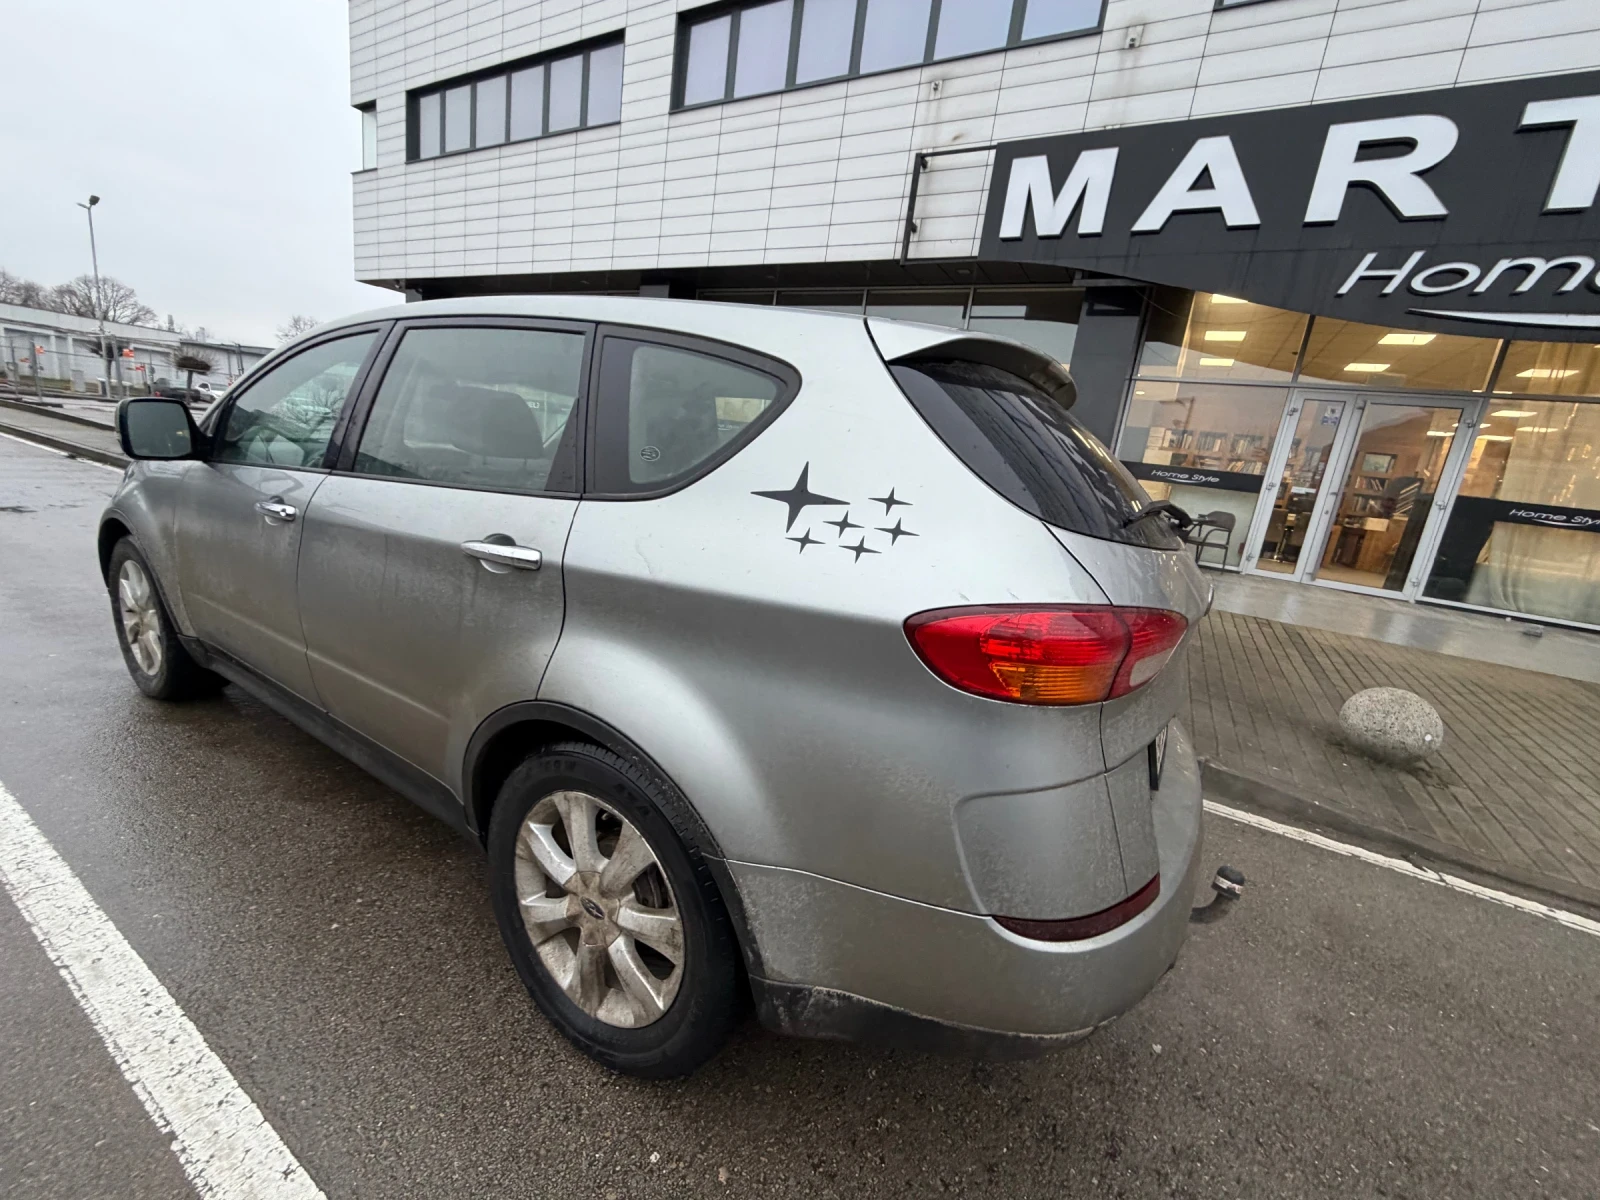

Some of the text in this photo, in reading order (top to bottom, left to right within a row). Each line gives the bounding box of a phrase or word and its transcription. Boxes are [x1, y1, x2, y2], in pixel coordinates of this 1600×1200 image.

[999, 94, 1600, 239] MART
[1336, 250, 1600, 294] Hom
[1151, 469, 1220, 483] Home Style
[1508, 508, 1567, 521] Home
